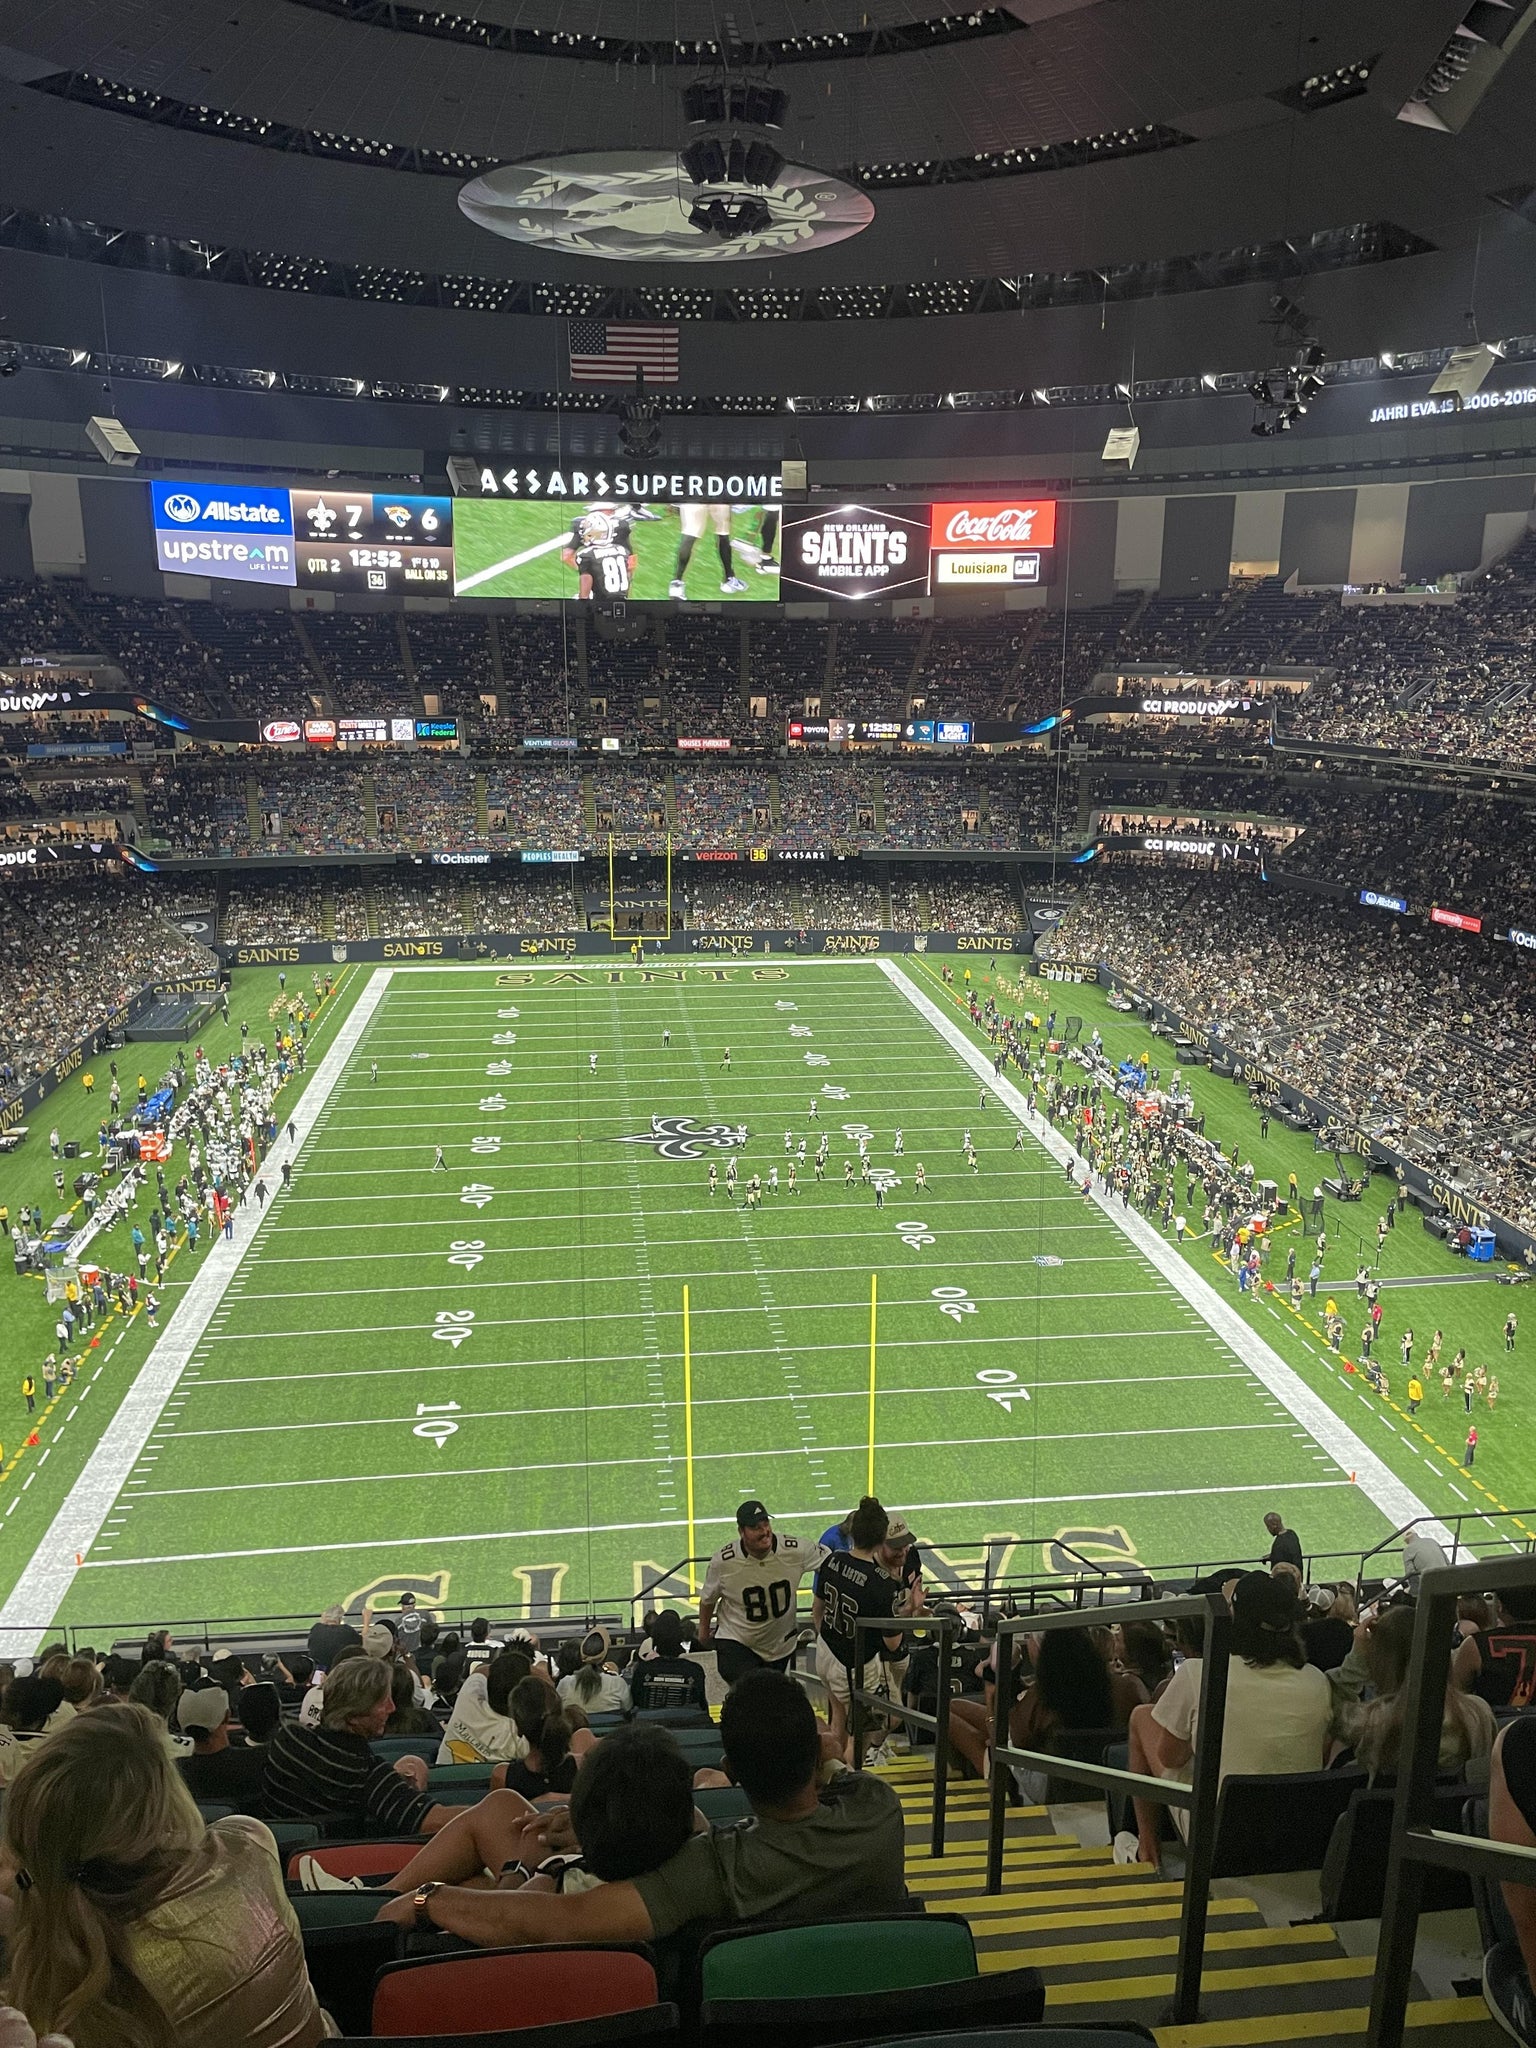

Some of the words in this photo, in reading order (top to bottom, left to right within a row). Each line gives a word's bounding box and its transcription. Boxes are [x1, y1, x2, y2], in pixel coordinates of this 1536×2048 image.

[1370, 405, 1408, 423] JAHRI
[615, 474, 783, 497] SUPERDOME
[345, 505, 363, 527] 7
[421, 508, 438, 530] 6
[823, 524, 843, 532] NEW
[846, 524, 885, 532] ORLEANS
[946, 509, 1038, 542] Coca-Cola
[802, 531, 907, 565] SAINTS
[307, 558, 328, 572] QTR
[331, 559, 341, 573] 2
[349, 549, 402, 567] 12:52
[602, 555, 629, 592] 81
[818, 564, 863, 576] MOBILE
[864, 564, 889, 576] APP
[951, 562, 1008, 575] Louisiana
[1014, 559, 1038, 575] CAT
[371, 574, 383, 586] 36
[1143, 700, 1161, 713] CCI
[430, 722, 455, 730] Keesler
[803, 726, 828, 734] TOYOTA
[847, 724, 855, 735] 7
[906, 724, 914, 735] 6
[943, 724, 963, 733] BUD
[939, 732, 967, 741] LIGHT
[1145, 839, 1163, 850] CCI
[441, 853, 490, 864] Ochsner
[522, 852, 551, 862] PEOPLES
[552, 851, 579, 862] HEALTH
[695, 851, 738, 861] verizon
[753, 849, 765, 860] 36
[778, 851, 825, 860] CAESARS
[520, 938, 577, 953] SAINTS
[699, 935, 753, 949] SAINTS
[826, 935, 880, 950] SAINTS
[957, 937, 1013, 950] SAINTS
[238, 947, 300, 964] SAINTS
[495, 969, 791, 986] SAINTS
[1040, 962, 1097, 981] SAINTS
[153, 979, 217, 994] SAINTS
[1180, 1021, 1209, 1048] SAINTS
[56, 1047, 82, 1083] SAINTS
[470, 1136, 501, 1153] 50
[460, 1183, 495, 1204] 40
[895, 1221, 936, 1244] 30
[447, 1240, 486, 1265] 30
[931, 1286, 979, 1315] 20
[431, 1310, 475, 1340] 20
[976, 1369, 1031, 1401] 10
[412, 1401, 461, 1438] 10
[742, 1579, 791, 1622] 80
[824, 1581, 858, 1639] 26
[1488, 1634, 1536, 1708] 7
